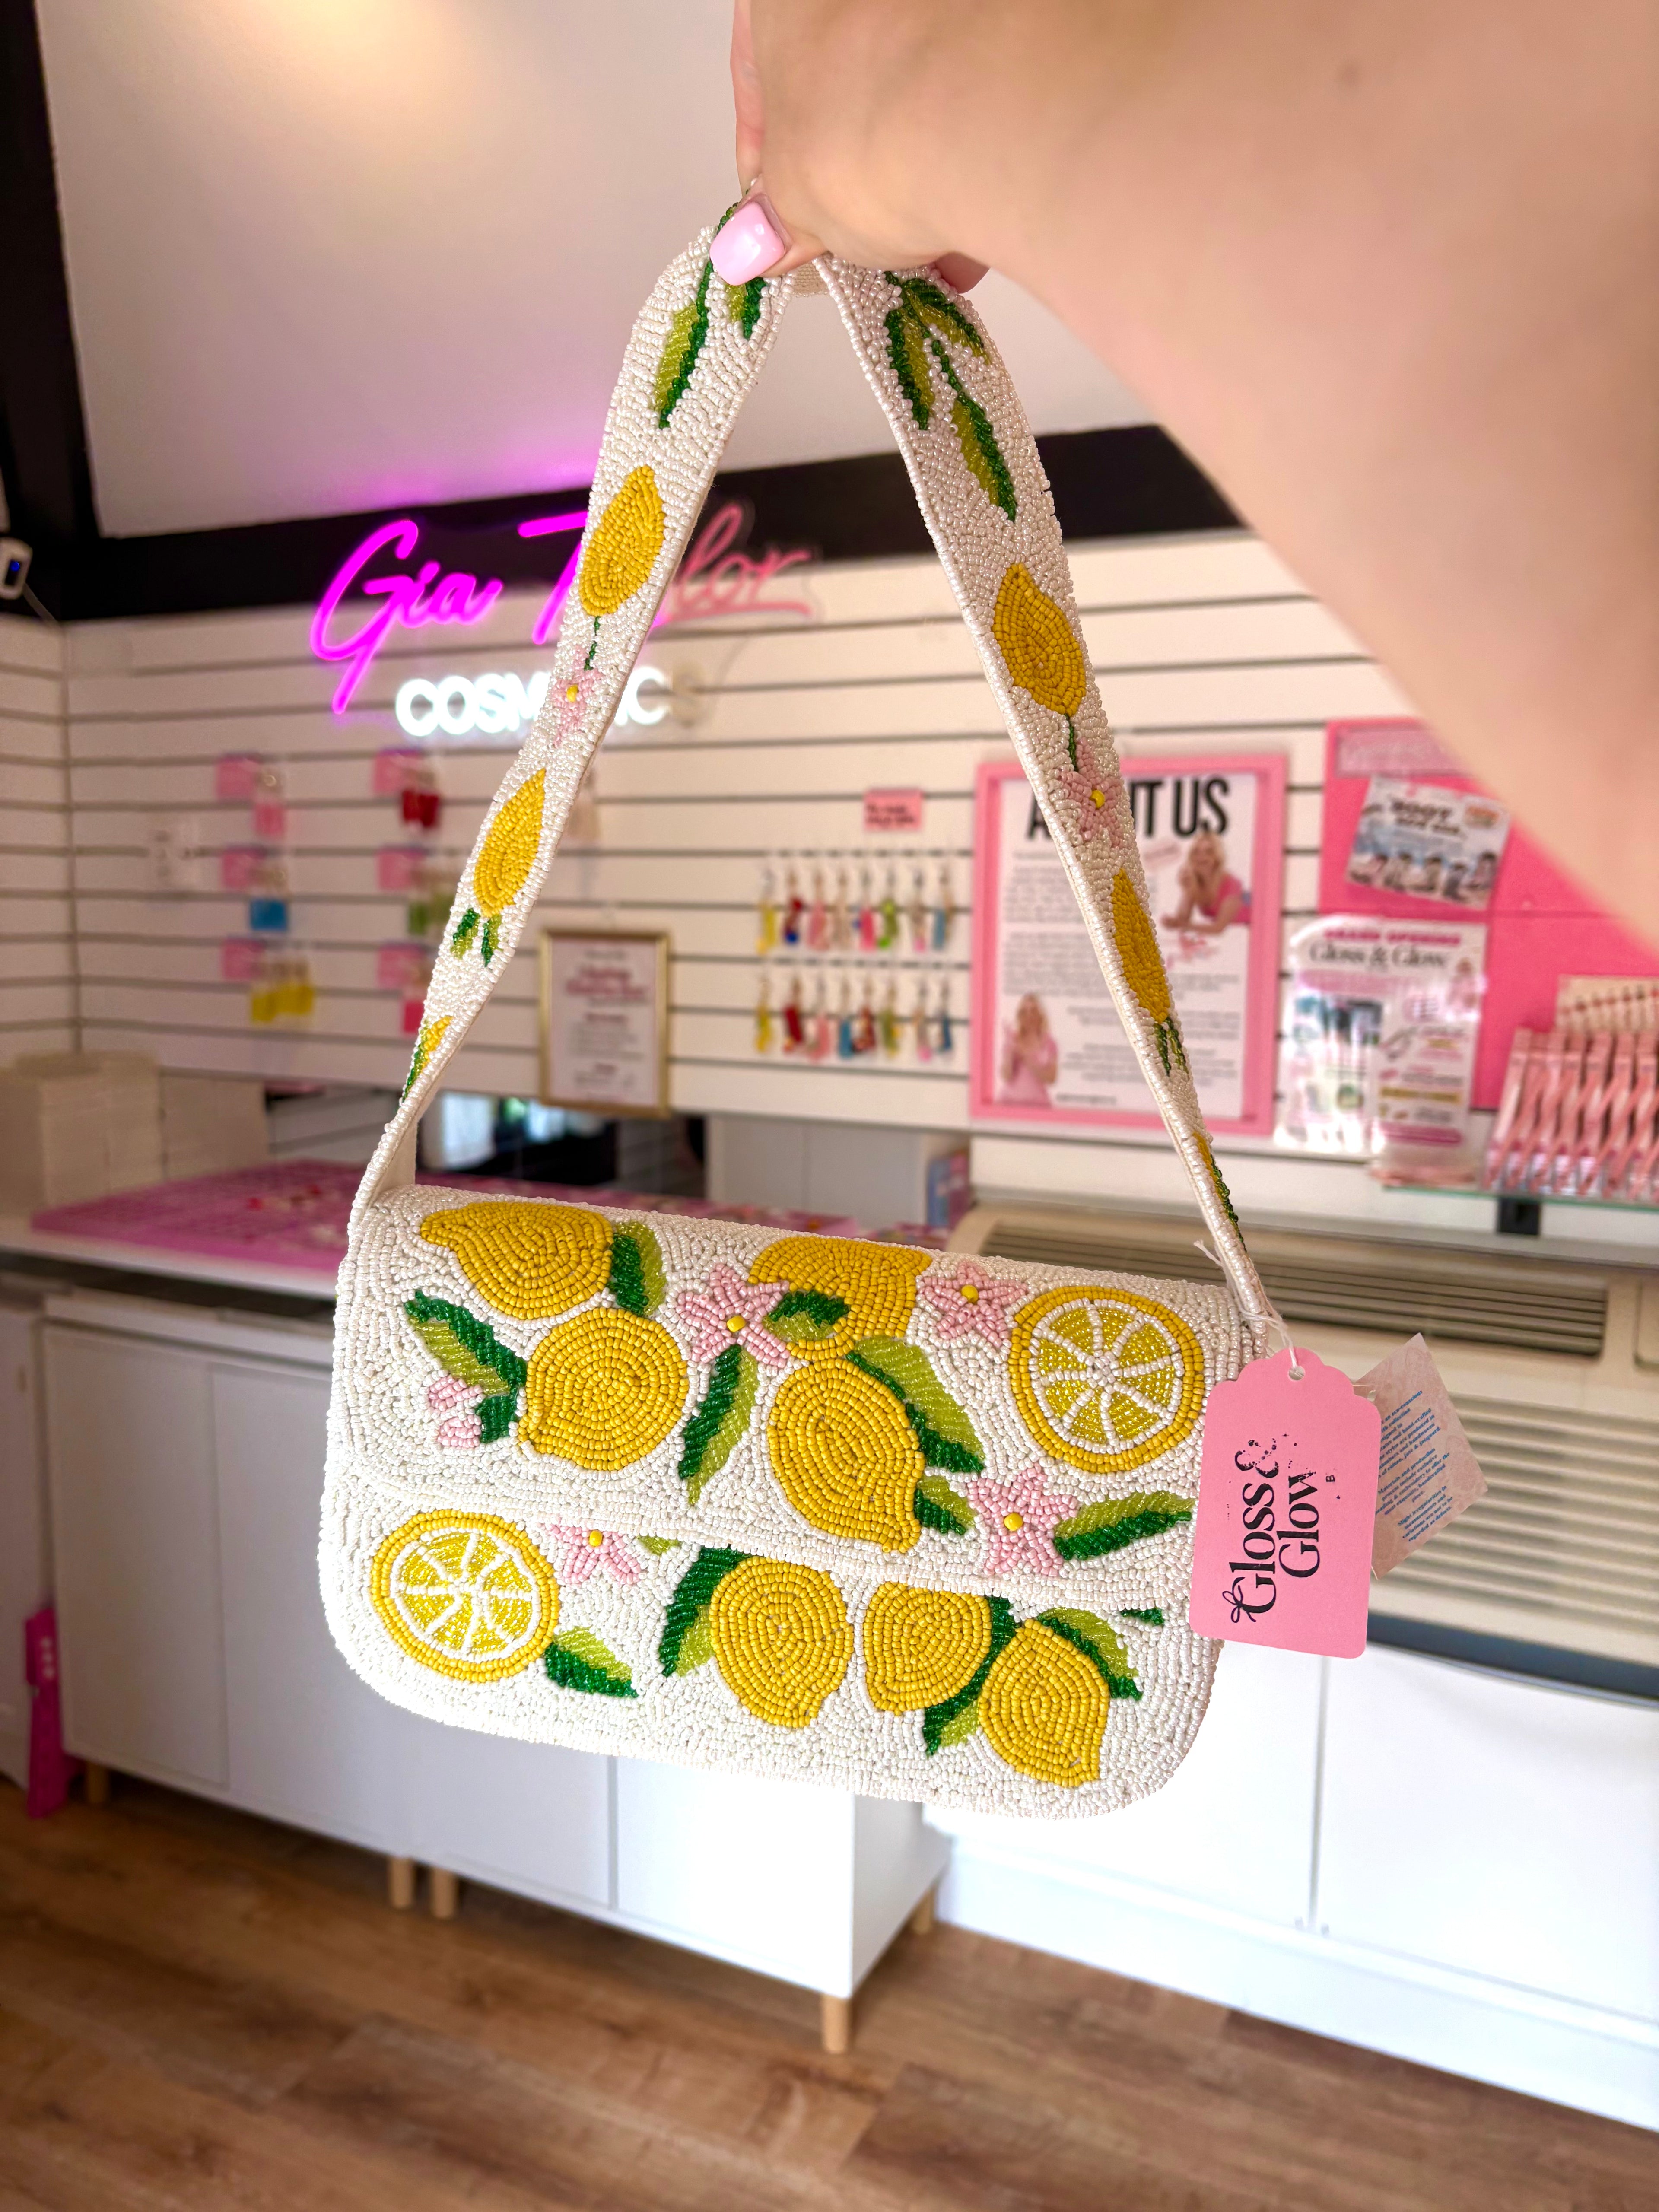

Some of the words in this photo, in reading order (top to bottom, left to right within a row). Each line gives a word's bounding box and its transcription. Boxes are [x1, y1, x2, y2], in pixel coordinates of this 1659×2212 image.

[309, 519, 503, 715] Gia
[518, 502, 810, 644] Tlor
[1172, 778, 1229, 837] US
[1392, 1432, 1402, 1441] and
[1407, 1418, 1429, 1439] produced
[1399, 1443, 1408, 1452] and
[1378, 1476, 1401, 1494] Materials
[1401, 1468, 1410, 1477] and
[1411, 1448, 1435, 1470] production
[1382, 1486, 1399, 1502] process
[1399, 1472, 1416, 1486] include
[1417, 1455, 1437, 1472] exclusive
[1418, 1463, 1446, 1488] handcrafted
[1431, 1459, 1441, 1469] offer
[1398, 1514, 1412, 1526] Slight
[1412, 1490, 1442, 1516] irregularities
[1437, 1494, 1446, 1503] and
[1276, 1469, 1321, 1578] Glow
[1408, 1523, 1429, 1542] regarded
[1228, 1483, 1277, 1615] Gloss
